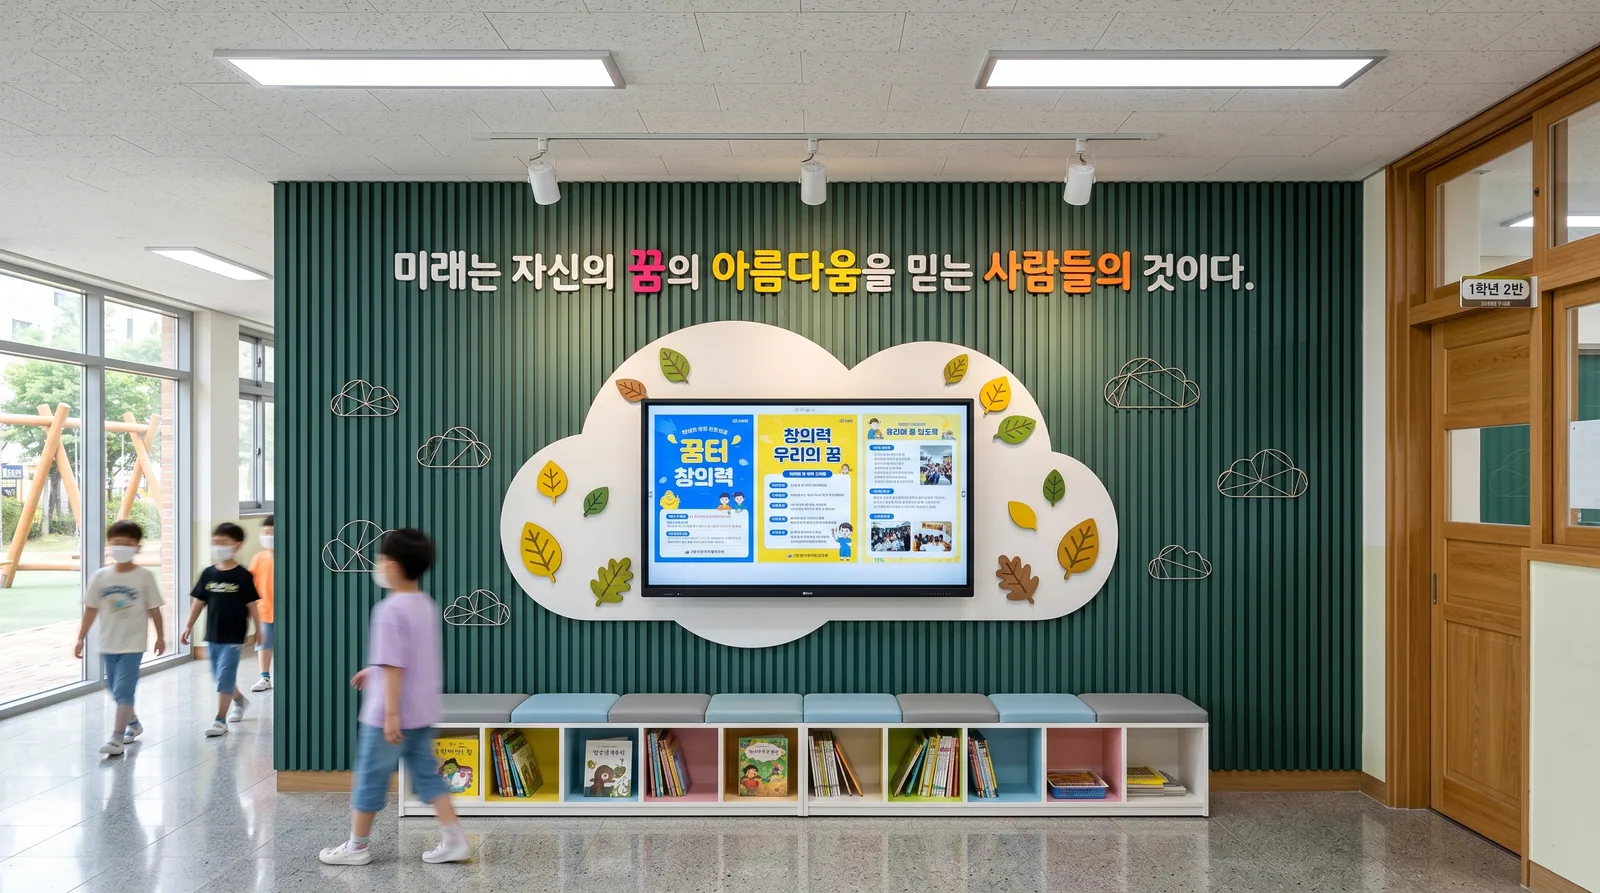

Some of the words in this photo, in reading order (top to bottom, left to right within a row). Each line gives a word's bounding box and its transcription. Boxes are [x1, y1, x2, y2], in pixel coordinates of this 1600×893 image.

[394, 250, 502, 291] 미래는
[511, 252, 615, 291] 자신의
[627, 249, 699, 293] 꿈의
[712, 249, 896, 293] 아름다움을
[906, 252, 974, 293] 믿는
[983, 249, 1132, 294] 사람들의
[1143, 252, 1255, 292] 것이다.
[1469, 282, 1499, 296] 1학년
[1503, 282, 1524, 296] 2반
[783, 427, 831, 444] 창의력
[679, 438, 728, 464] 꿈터
[773, 446, 820, 463] 우리의
[826, 446, 841, 463] 꿈
[674, 466, 734, 488] 창의력
